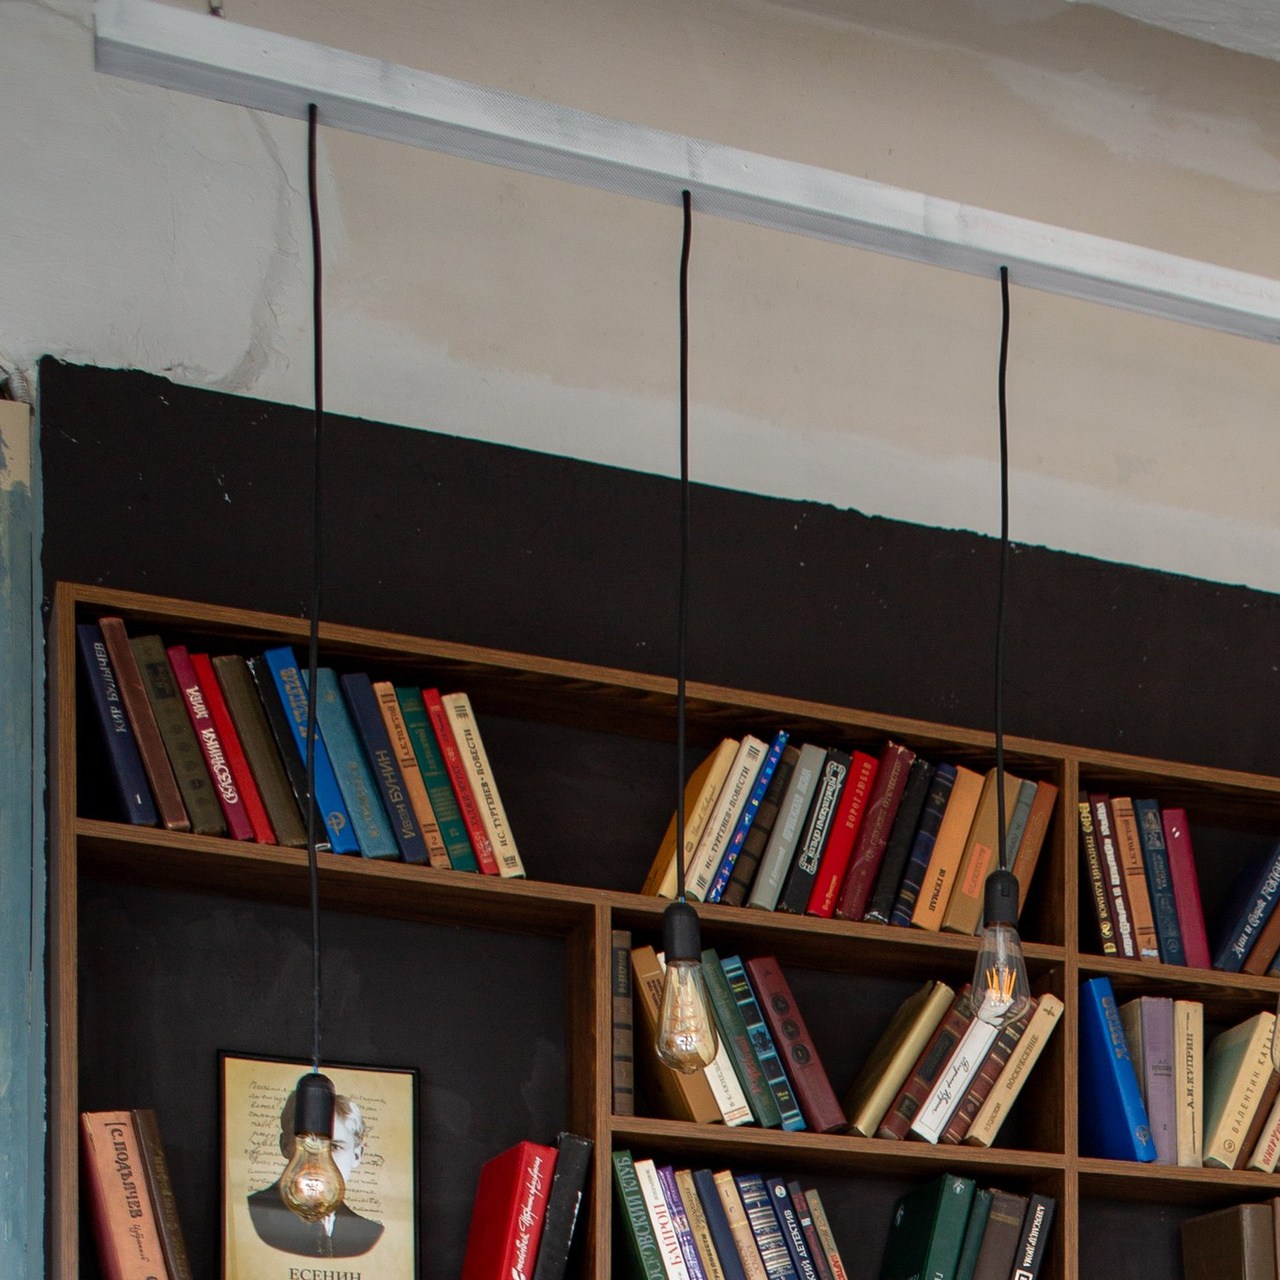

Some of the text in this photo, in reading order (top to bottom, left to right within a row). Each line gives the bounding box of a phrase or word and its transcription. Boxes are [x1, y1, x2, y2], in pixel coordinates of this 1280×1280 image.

[93, 640, 126, 733] КИР БУЛЫЧЕВ
[185, 684, 239, 805] СКАЗОЧНИКИ МИРА
[375, 747, 415, 838] Иван БУНИН
[463, 727, 502, 829] ТУРГЕНЕВ ПОВЕСТИ
[710, 766, 750, 853] ТУРГЕНЕВ ПОВЕСТИ
[844, 796, 862, 828] ПОРОГ
[927, 877, 944, 910] ГЕРМАН
[1084, 834, 1108, 917] ГРИГОРИЙ КЛИМОВ
[1229, 932, 1251, 958] Анн
[1003, 1034, 1040, 1090] ВОСКРЕСЕНИЕ
[1185, 1032, 1194, 1109] А.И.КУПРИН
[1230, 1070, 1261, 1133] ВАЛЕНТИН
[107, 1126, 142, 1219] С.ПОДЪЯЧЕВ
[613, 1156, 638, 1193] КЛУБ
[652, 1204, 683, 1267] БАЙРОН
[700, 1233, 716, 1267] ПОВЕСТИ
[782, 1209, 807, 1260] ДЕТЕКТИВ
[1020, 1203, 1047, 1268] АЛЕКСАНДР ДЮМА
